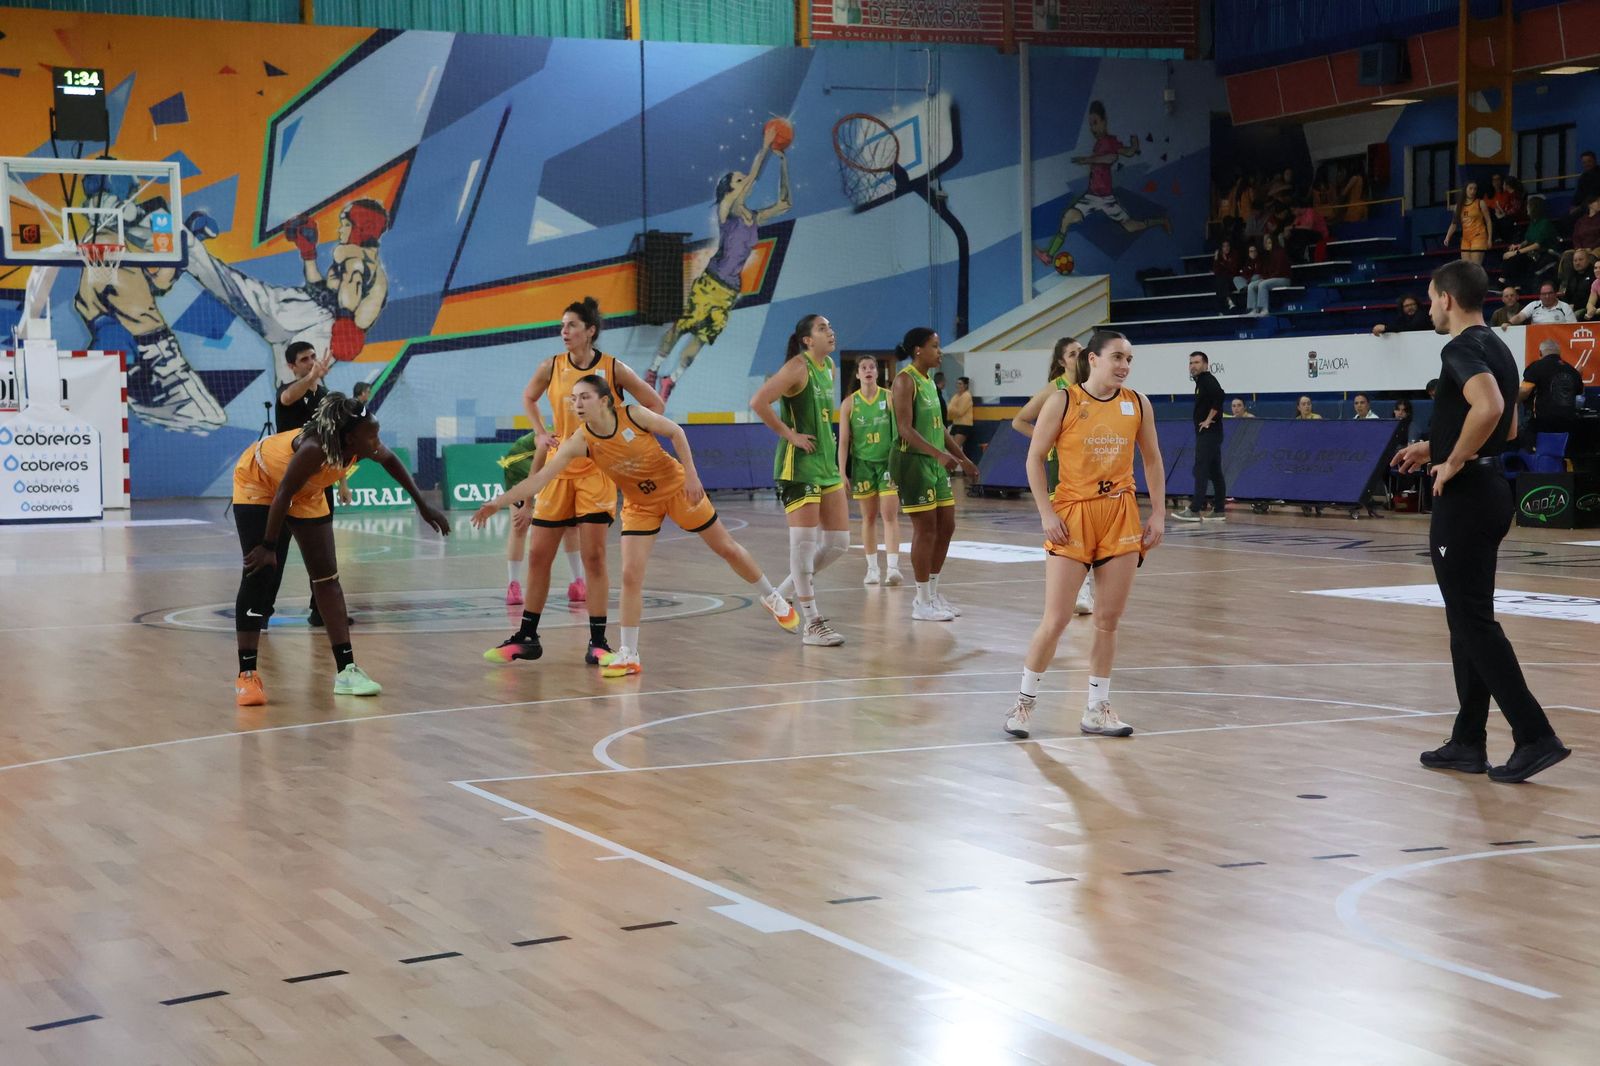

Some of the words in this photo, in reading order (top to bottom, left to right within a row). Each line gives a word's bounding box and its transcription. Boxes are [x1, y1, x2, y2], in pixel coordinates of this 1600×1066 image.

[869, 6, 893, 25] DE
[898, 6, 983, 27] ZAMORA
[64, 70, 99, 86] 1:34
[1210, 362, 1226, 375] ORA
[1319, 357, 1350, 371] ZAMORA
[15, 432, 91, 446] cobreros
[1084, 434, 1128, 445] recoletas
[1094, 445, 1120, 455] salud
[20, 459, 88, 472] cobreros
[26, 483, 80, 493] cobreros
[454, 483, 505, 502] CAJA
[638, 479, 657, 495] 55
[31, 504, 73, 512] cobreros
